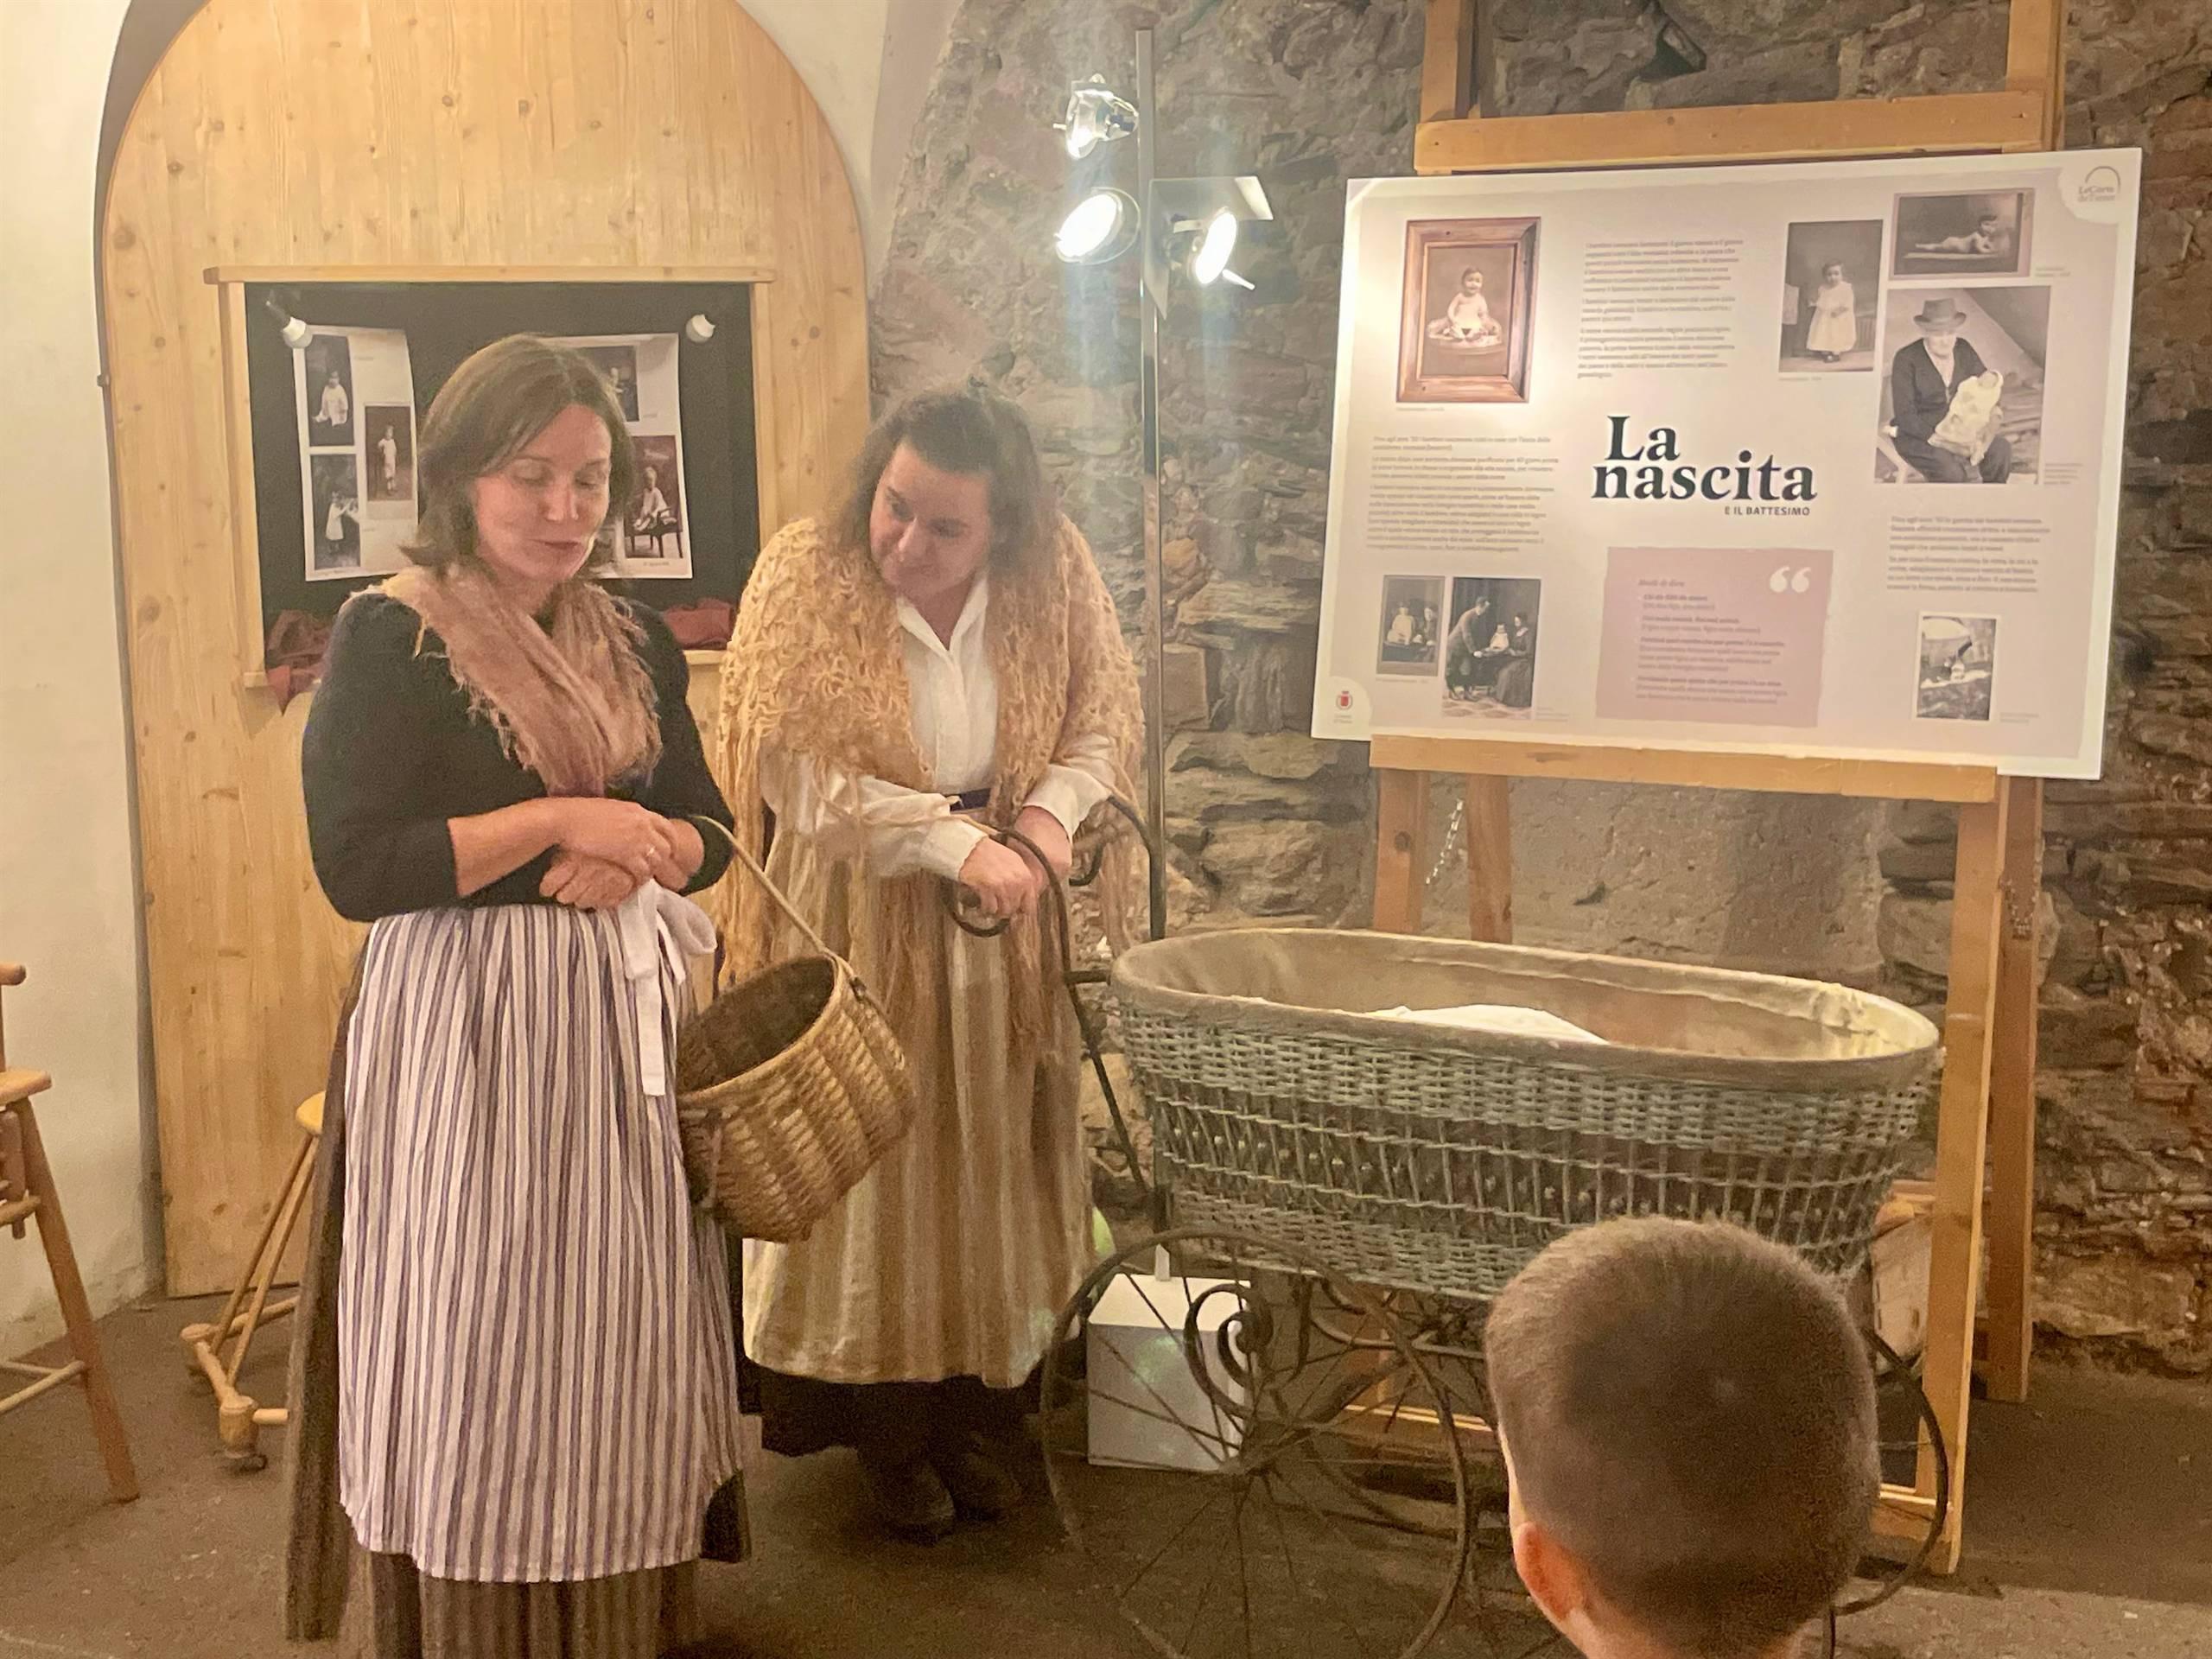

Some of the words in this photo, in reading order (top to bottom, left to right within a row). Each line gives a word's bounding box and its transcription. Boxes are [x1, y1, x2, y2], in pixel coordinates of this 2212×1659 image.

[1604, 415, 1681, 461] La
[1591, 449, 1817, 501] nascita
[1724, 505, 1730, 515] E
[1733, 505, 1743, 515] IL
[1745, 506, 1810, 516] BATTESIMO
